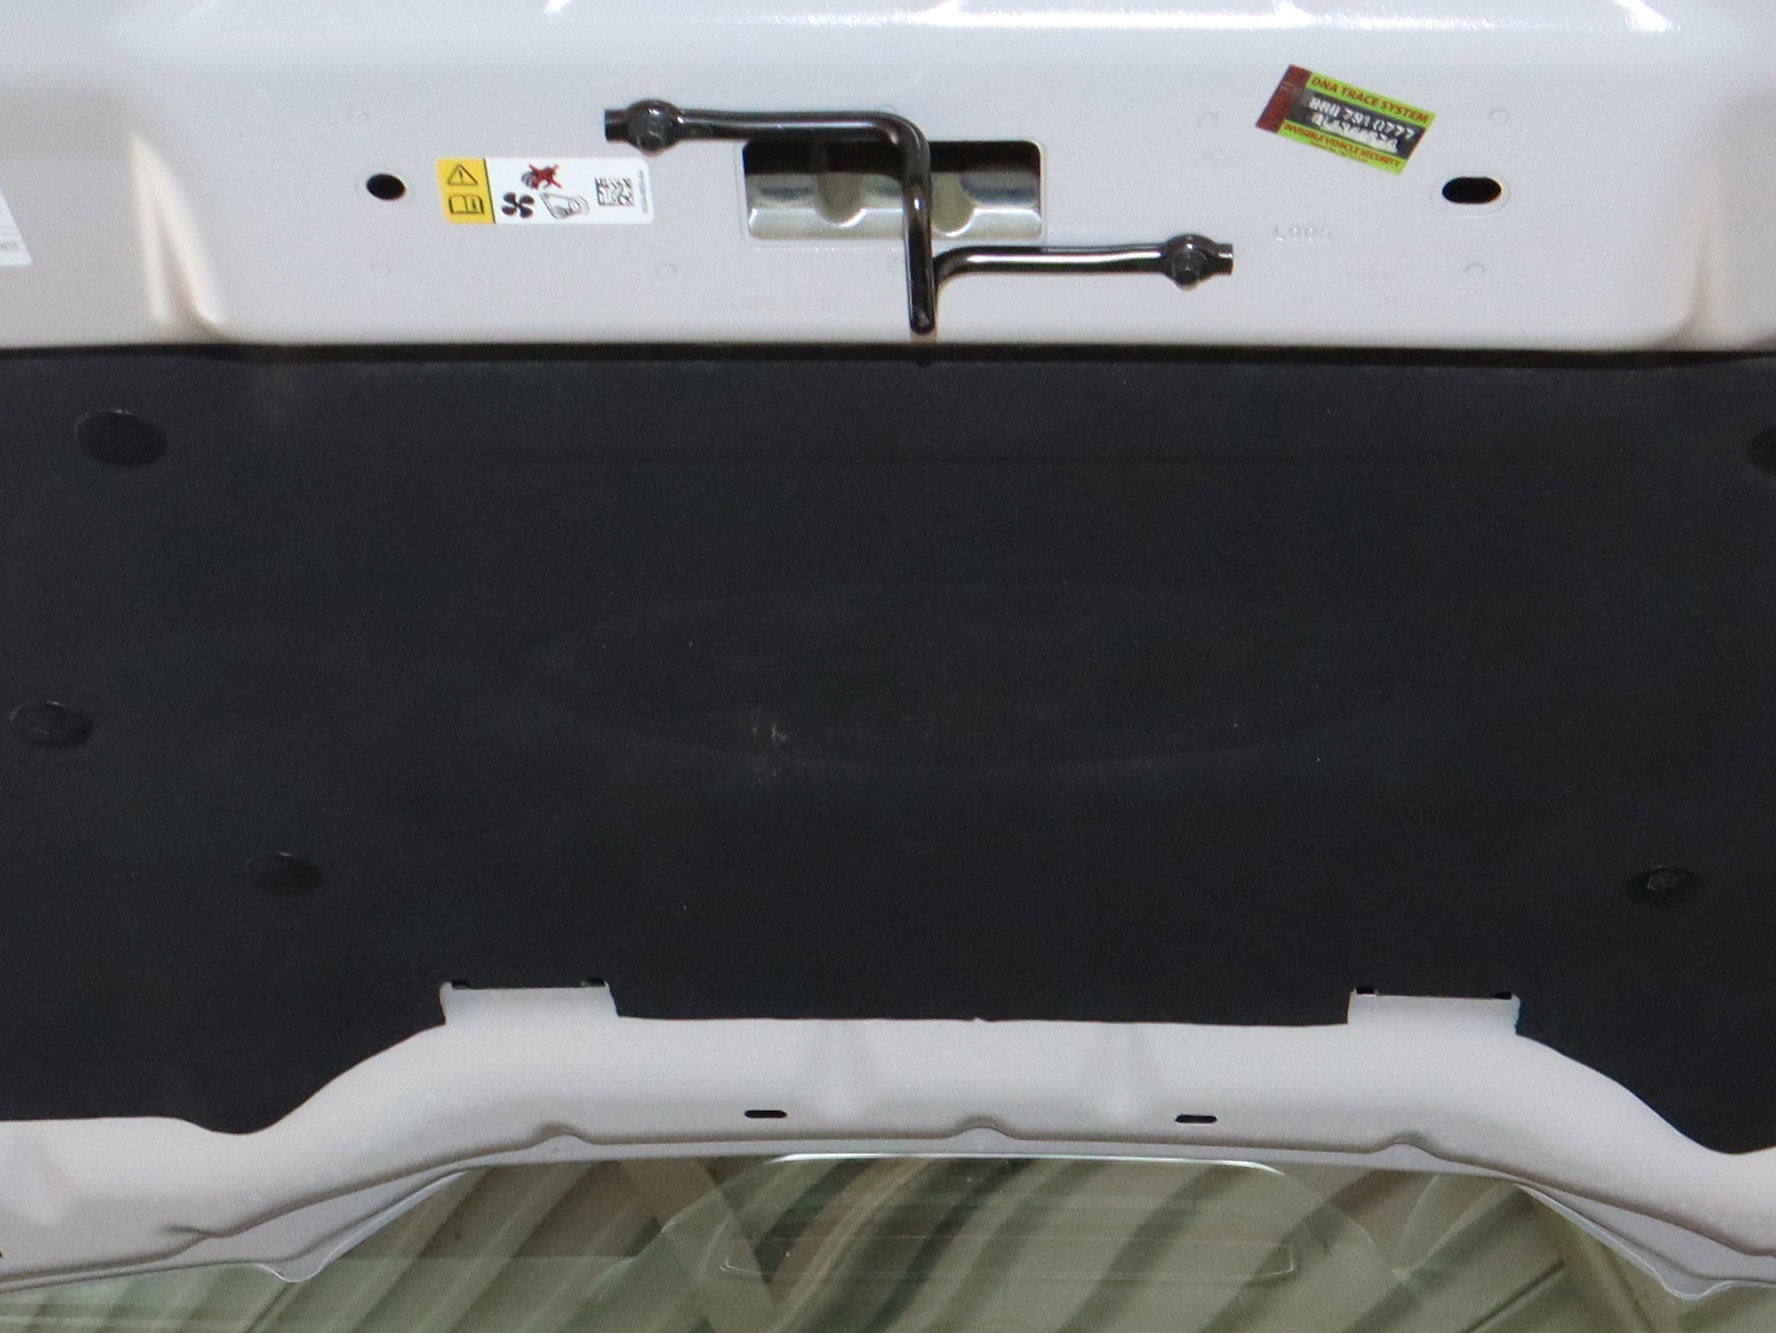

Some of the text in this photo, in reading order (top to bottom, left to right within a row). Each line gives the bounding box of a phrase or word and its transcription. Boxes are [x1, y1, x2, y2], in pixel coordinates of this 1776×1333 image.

[1312, 77, 1338, 92] DNA
[1342, 85, 1380, 107] TRACE
[1381, 100, 1429, 122] SYSTEM
